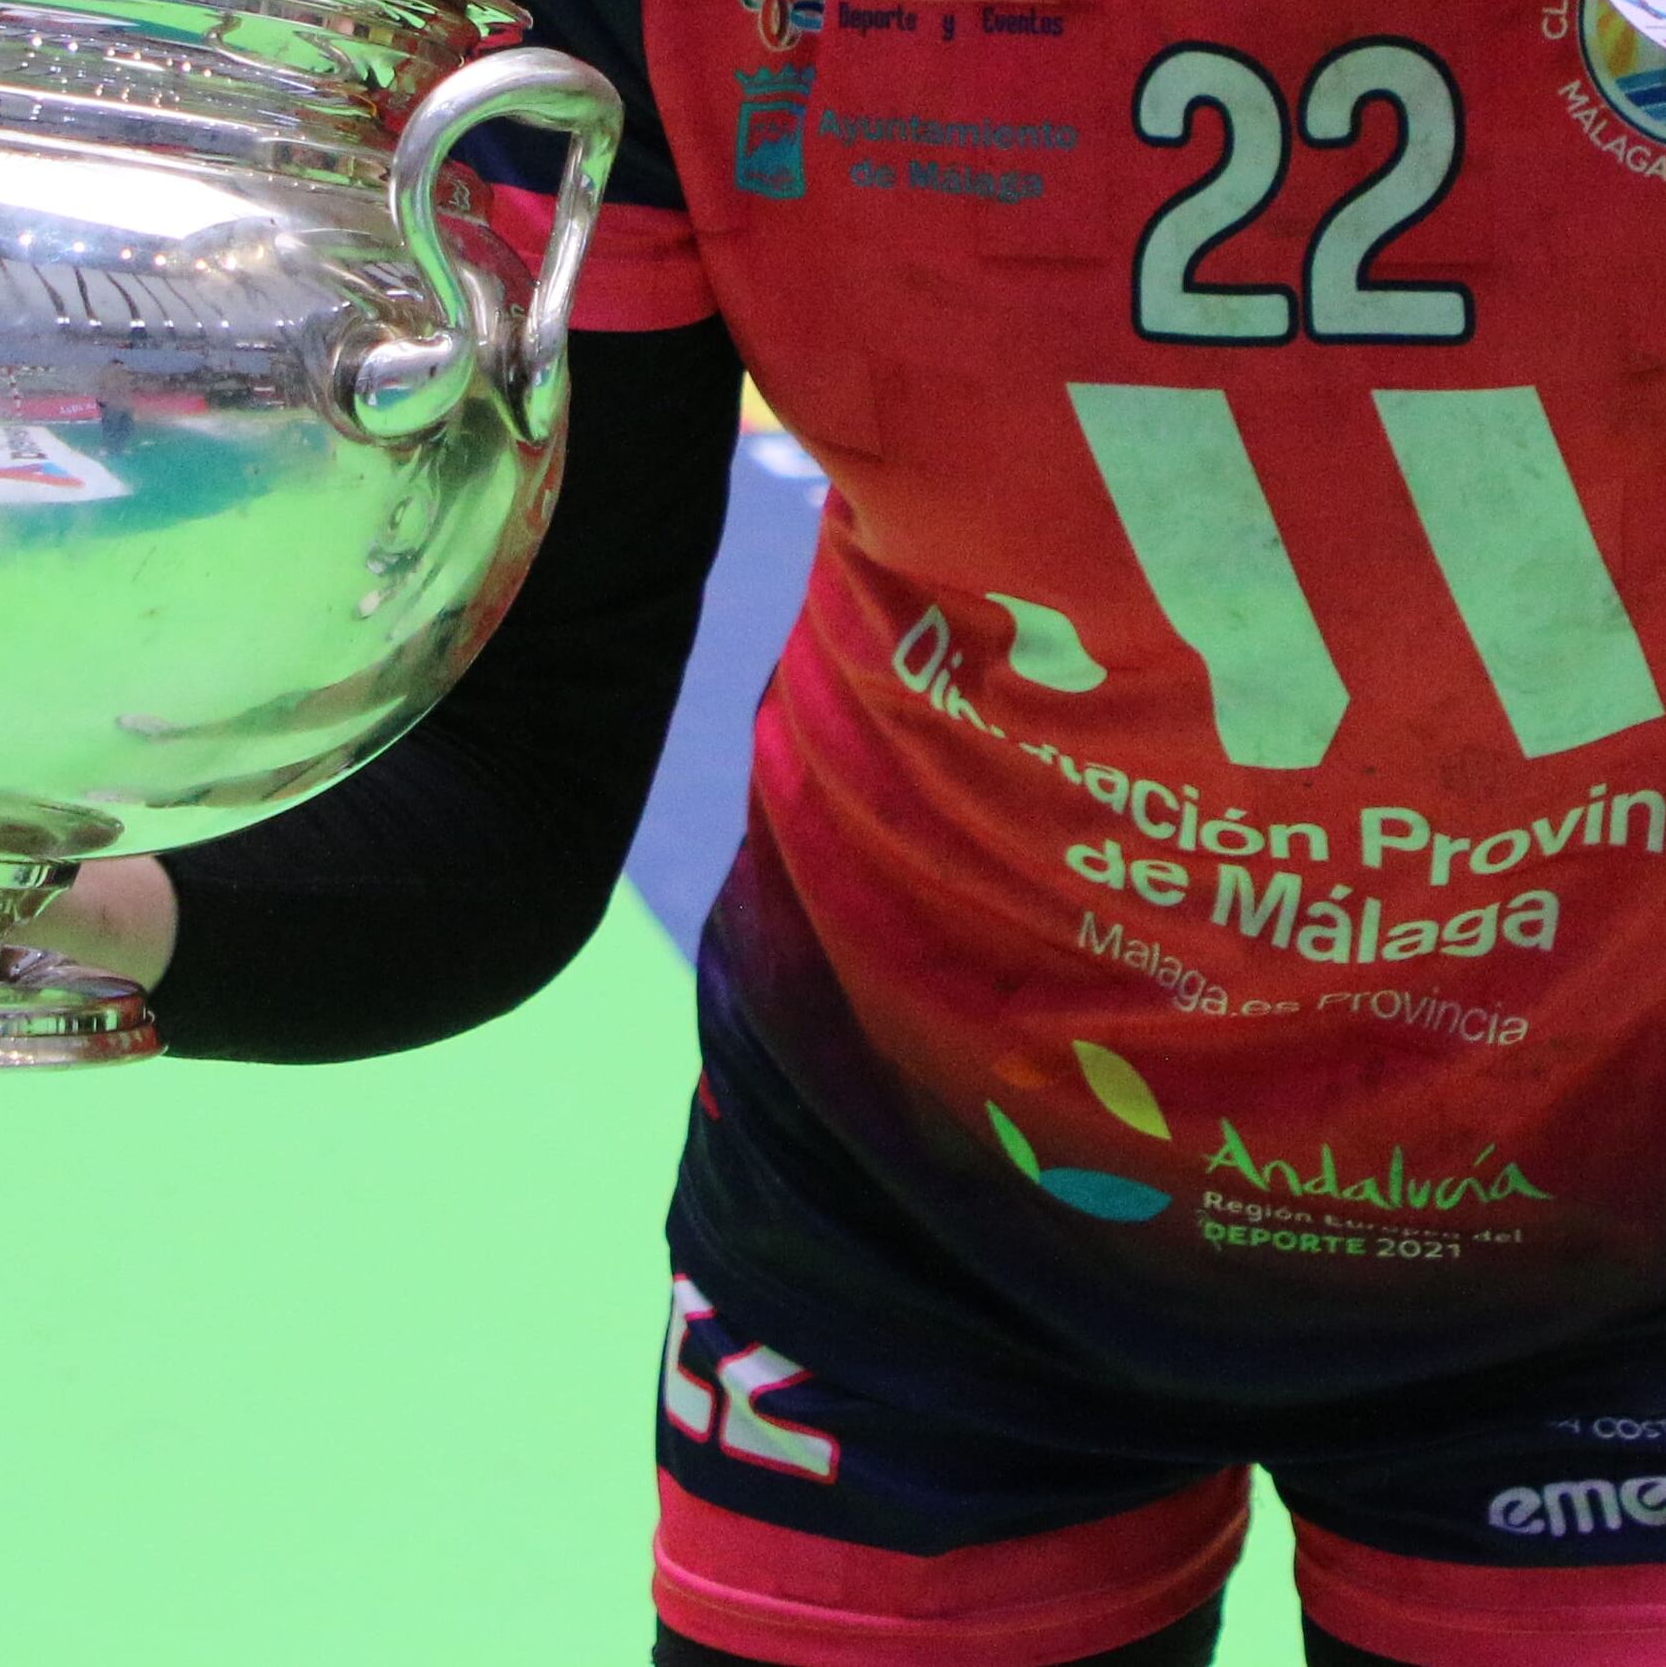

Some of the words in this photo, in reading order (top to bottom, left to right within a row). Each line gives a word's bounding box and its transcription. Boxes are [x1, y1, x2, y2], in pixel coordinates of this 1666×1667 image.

[941, 12, 957, 42] y
[982, 7, 1065, 37] Eventos
[817, 108, 1080, 152] Ayuntamiento
[848, 158, 896, 190] de
[907, 157, 1046, 205] Málaga
[1133, 34, 1474, 347] 22
[891, 603, 1331, 863] Diación
[1064, 838, 1192, 907] de
[1210, 861, 1561, 965] Málaga
[1316, 985, 1530, 1047] Provincia
[1203, 1116, 1555, 1210] Andalucía
[1202, 1221, 1367, 1256] DEPORTE
